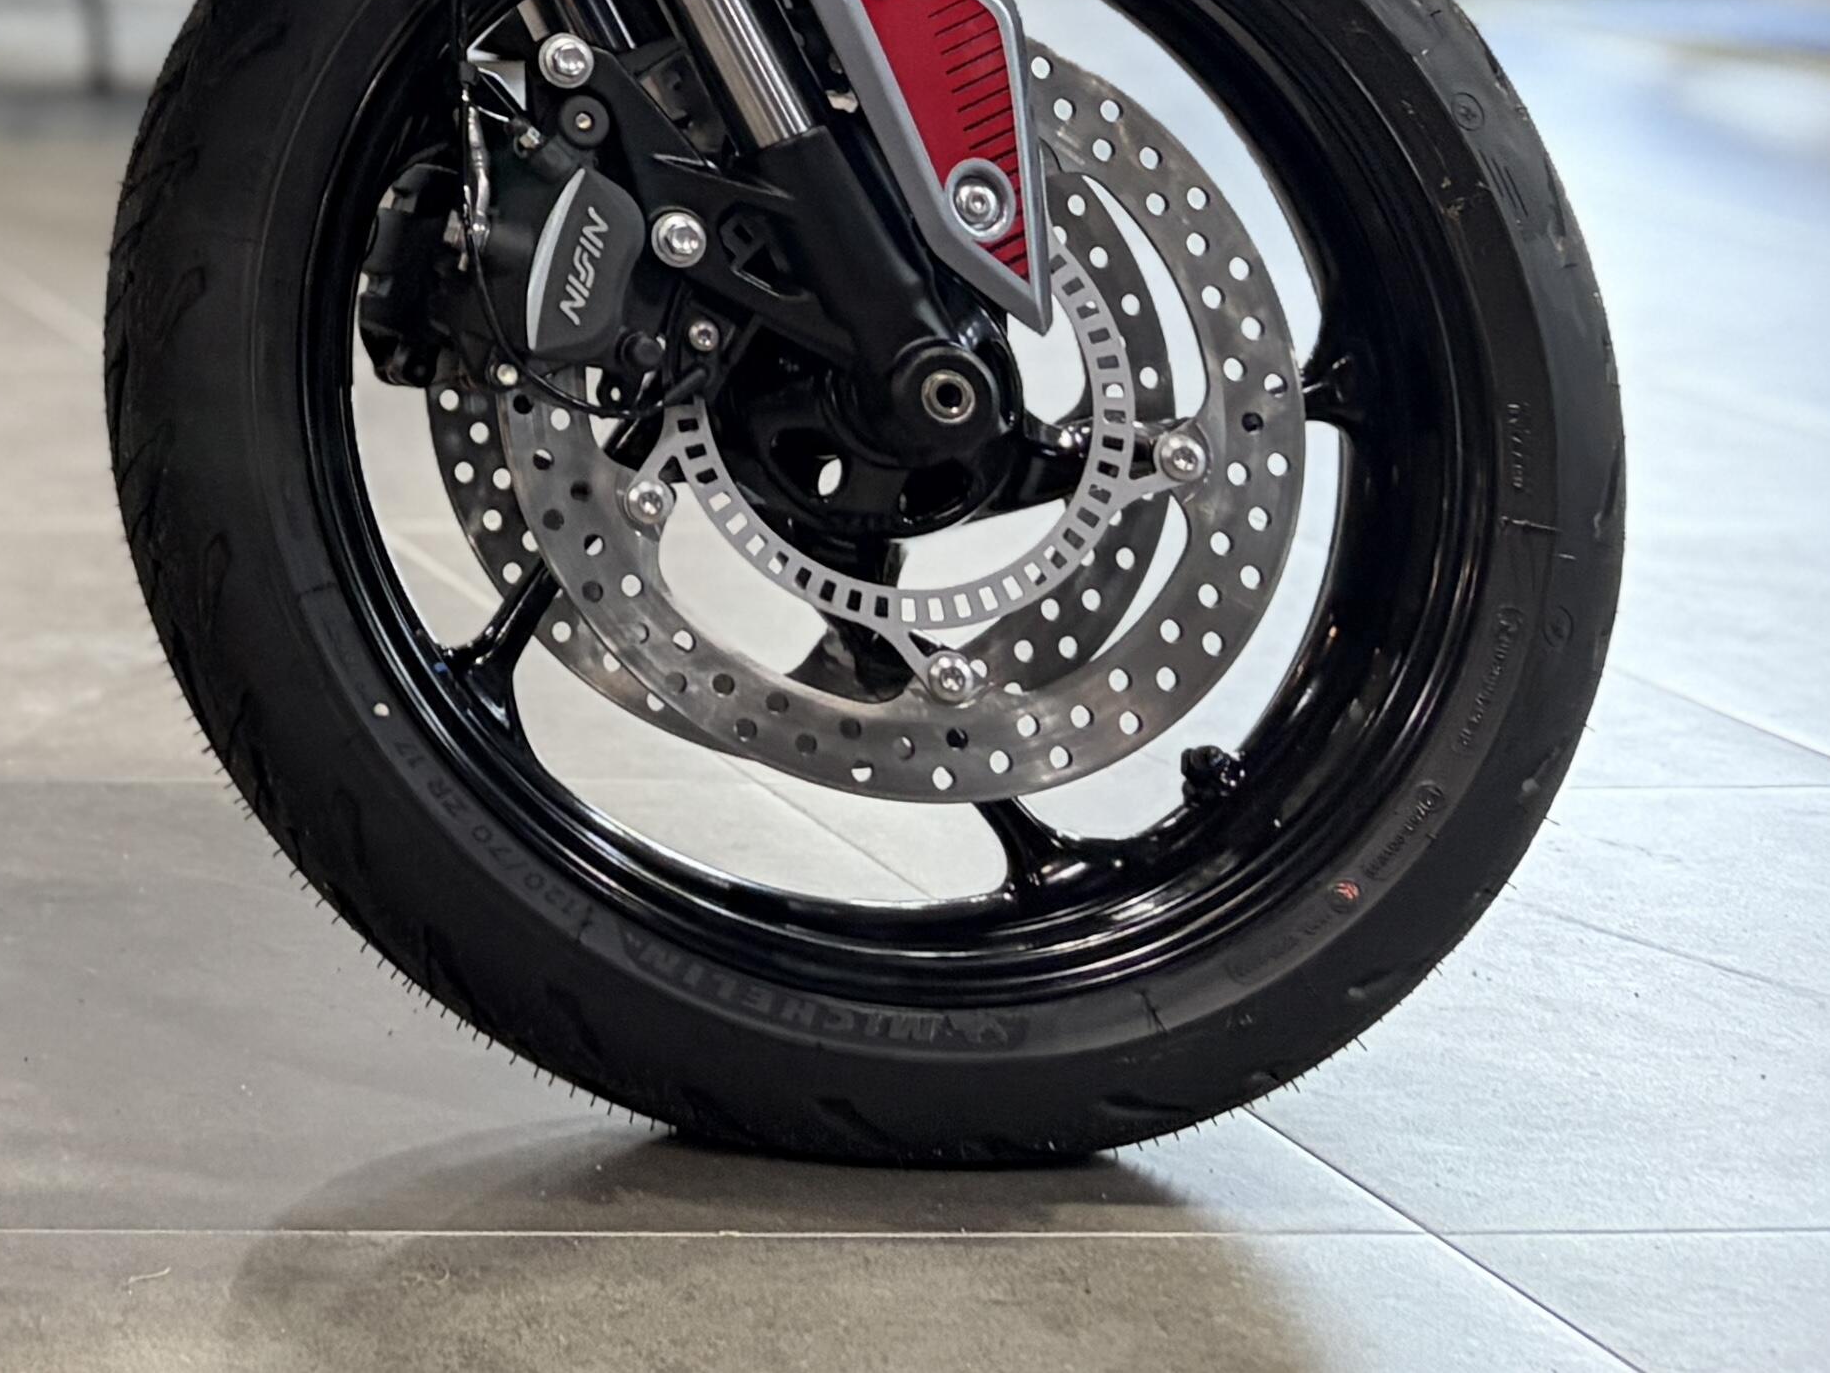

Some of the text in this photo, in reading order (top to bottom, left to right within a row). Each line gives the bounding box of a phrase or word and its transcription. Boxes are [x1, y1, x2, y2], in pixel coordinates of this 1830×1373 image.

[393, 741, 576, 915] 120/70 ZR 17
[637, 938, 939, 1044] MICHELIN
